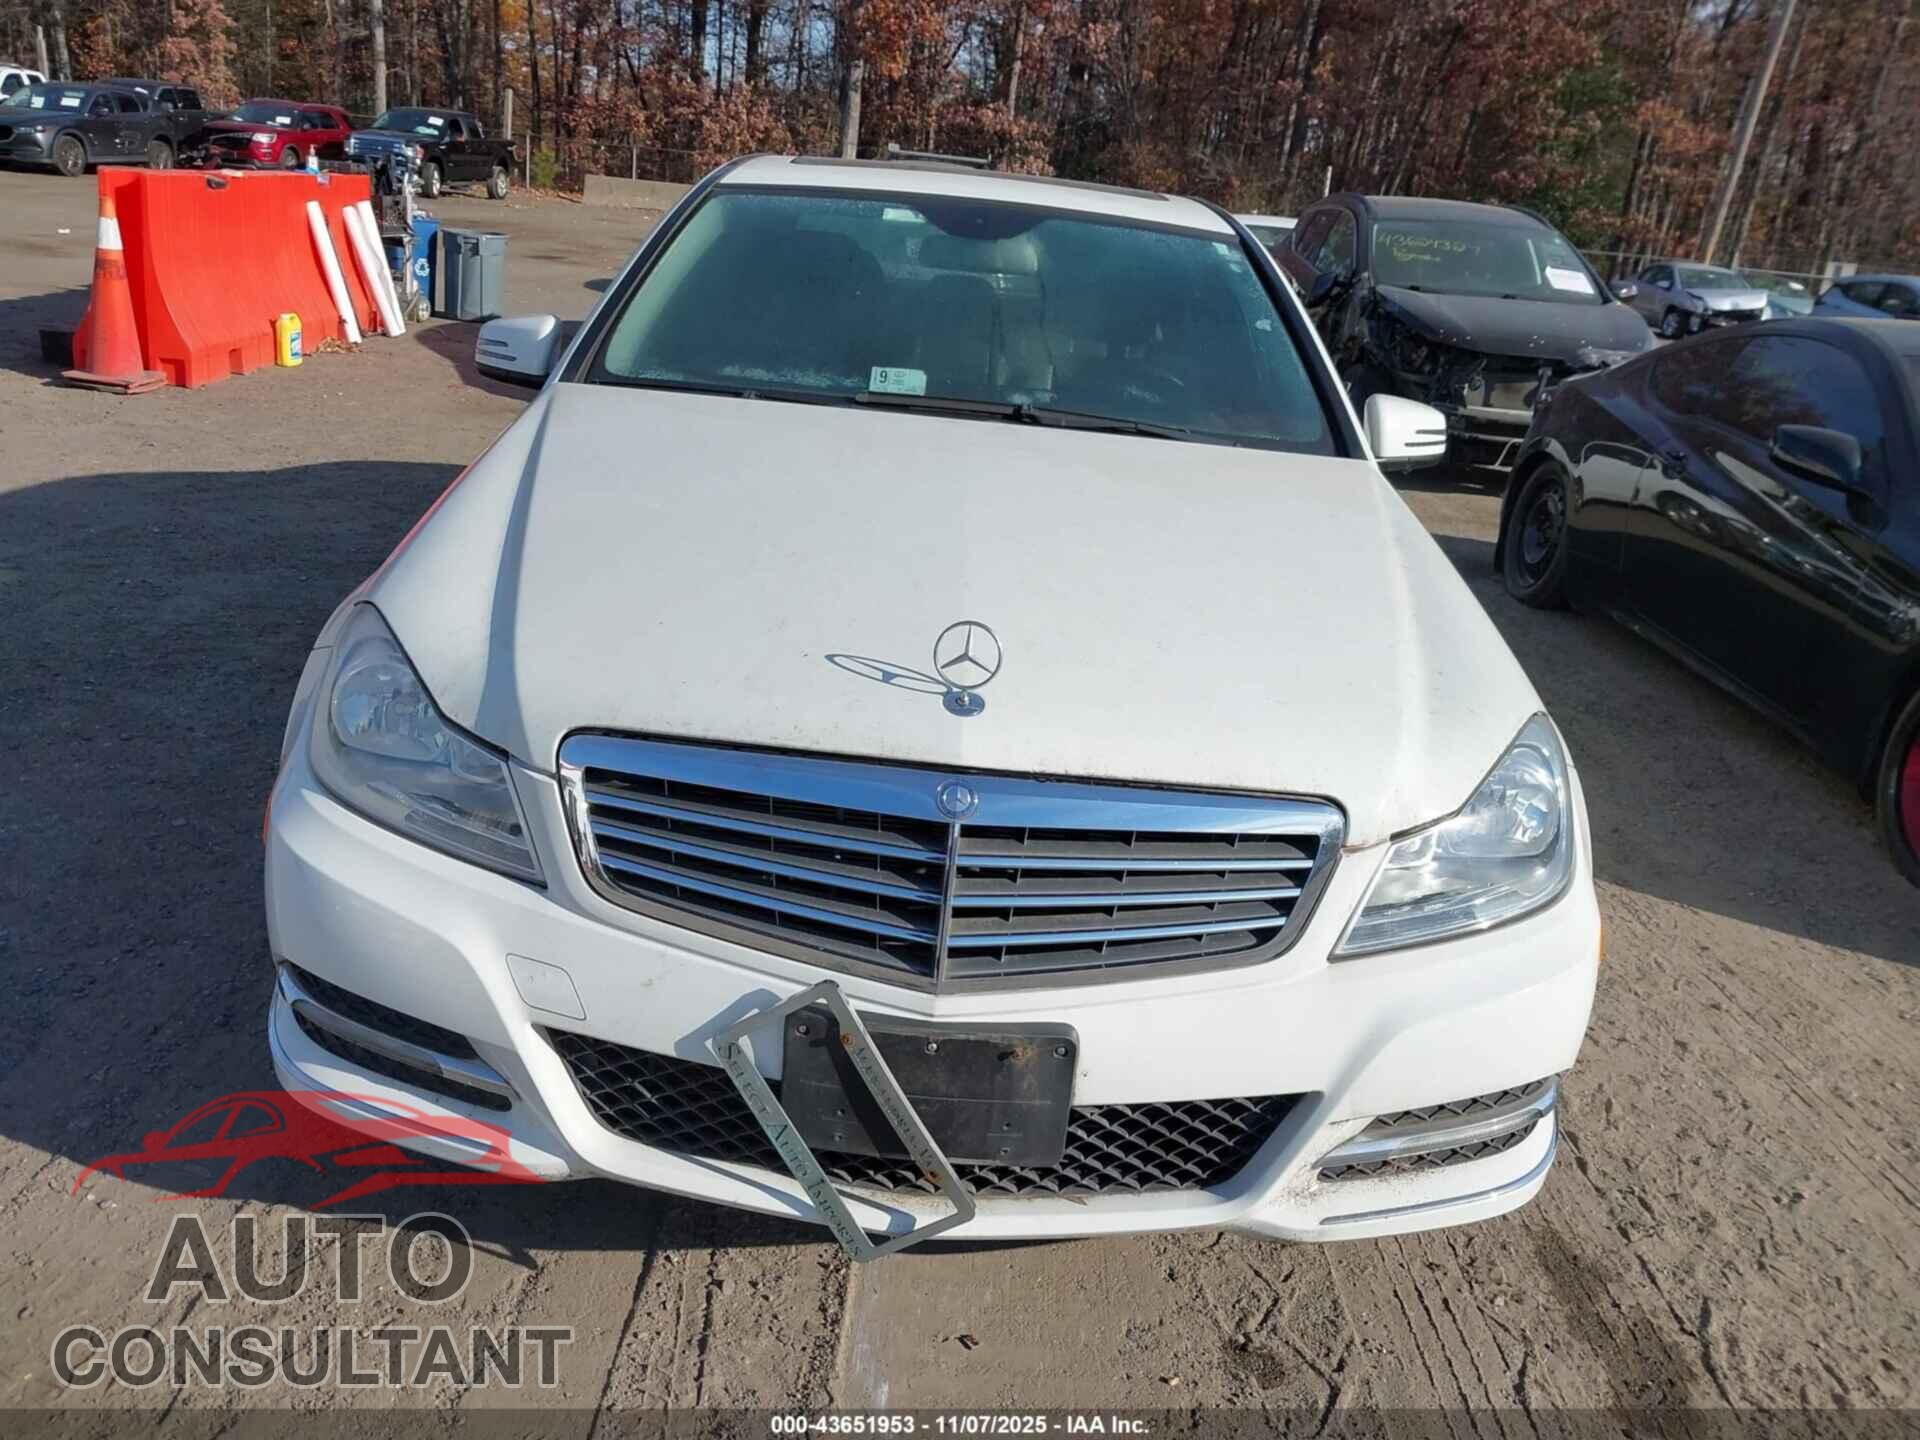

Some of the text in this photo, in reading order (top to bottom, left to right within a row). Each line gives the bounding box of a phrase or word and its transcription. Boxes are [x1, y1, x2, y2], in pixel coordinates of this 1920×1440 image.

[880, 370, 888, 384] 9
[718, 1041, 862, 1257] SELECT AUTO IMPORTS
